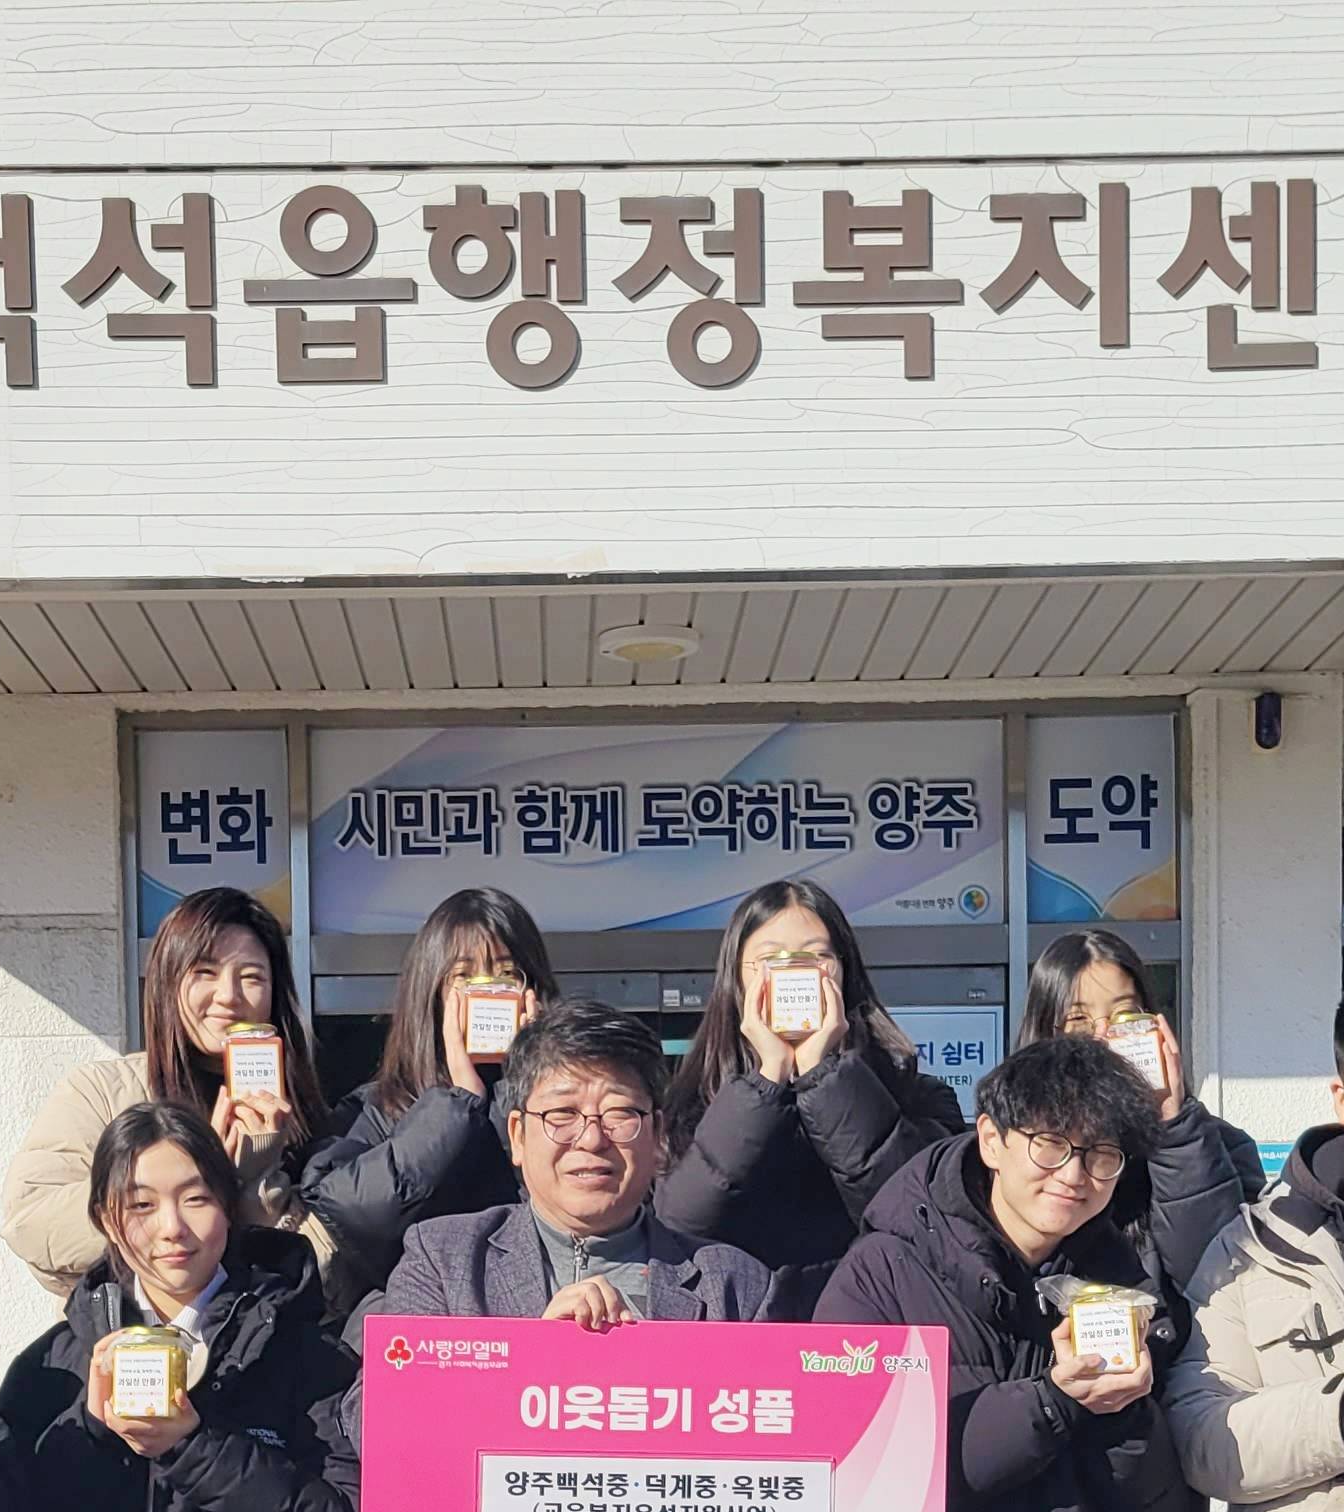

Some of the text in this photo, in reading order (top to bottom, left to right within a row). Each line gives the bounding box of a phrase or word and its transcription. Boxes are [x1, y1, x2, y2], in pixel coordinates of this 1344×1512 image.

[159, 787, 274, 865] 변화
[337, 781, 977, 857] 시민과 함께 도약하는 양주
[1042, 772, 1159, 851] 도약
[937, 897, 955, 910] 양주
[941, 1041, 984, 1066] 쉼터
[416, 1340, 509, 1361] 사랑의열매
[882, 1356, 930, 1373] 양주시
[520, 1385, 795, 1435] 이웃돕기 성품
